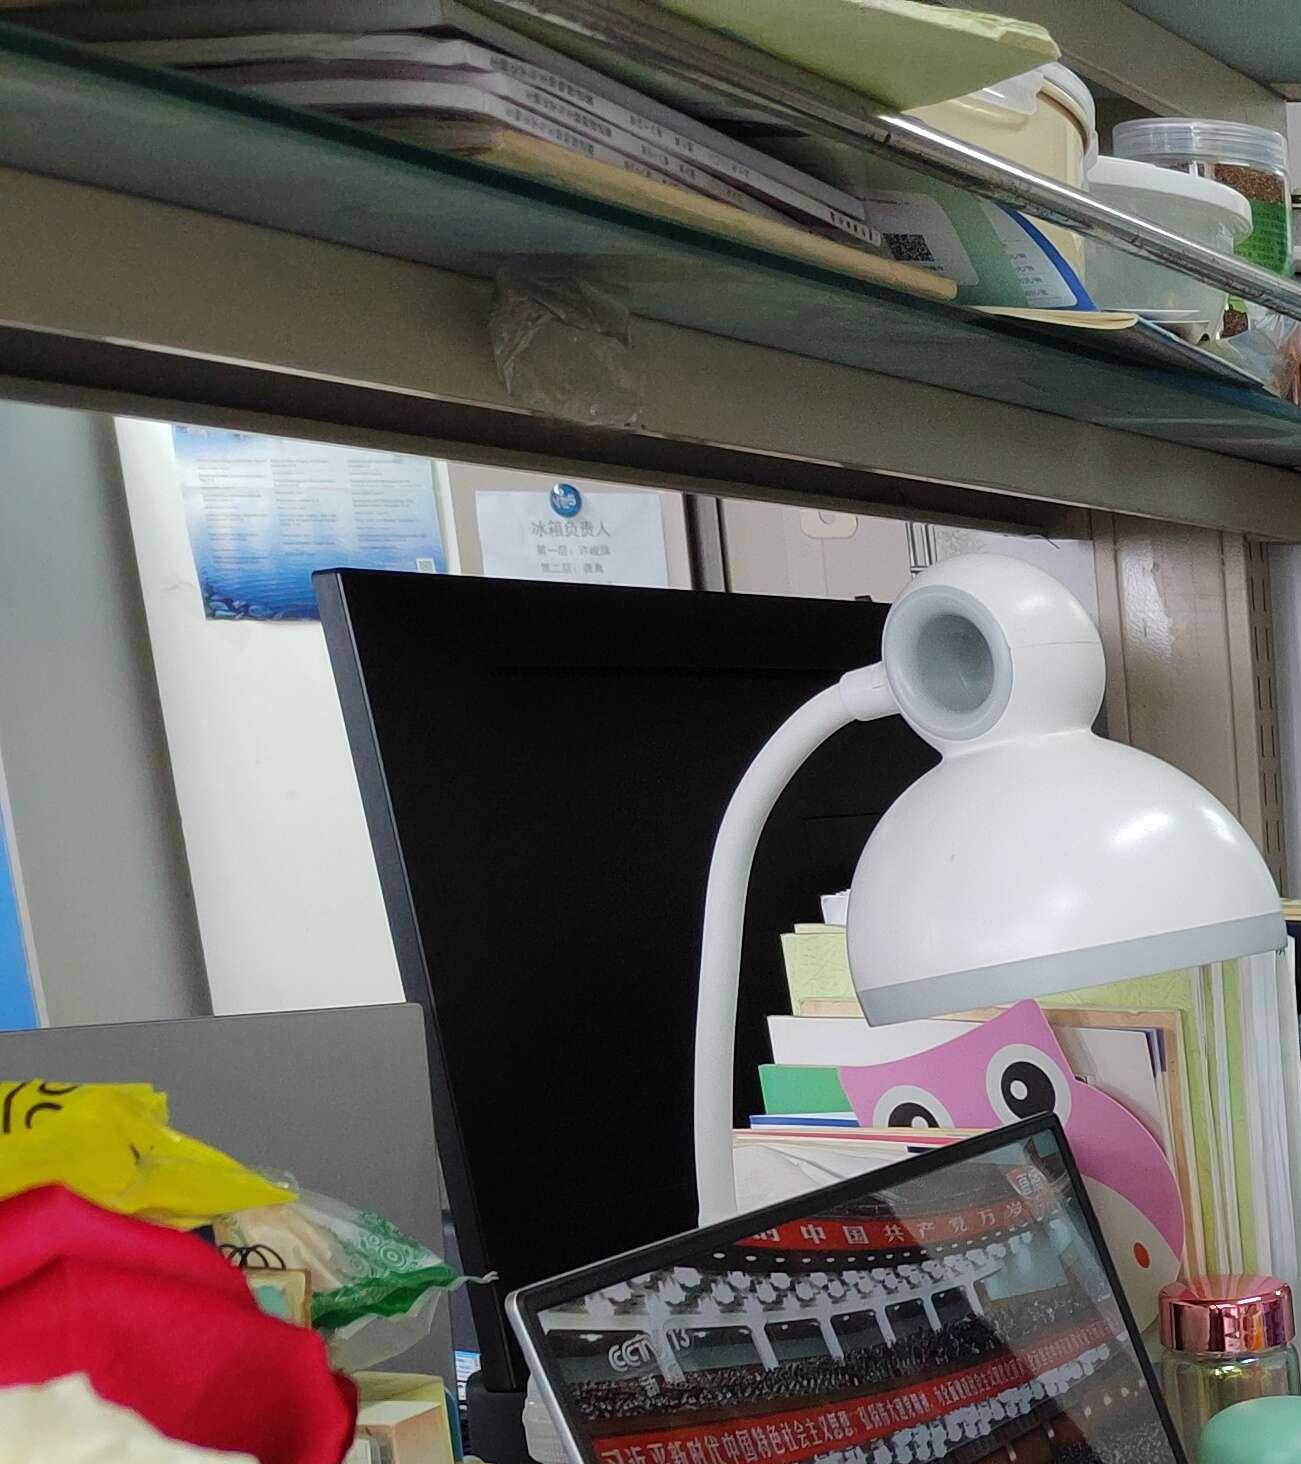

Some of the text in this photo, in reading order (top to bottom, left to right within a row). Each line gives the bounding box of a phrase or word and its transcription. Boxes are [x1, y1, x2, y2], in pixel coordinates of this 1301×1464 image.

[531, 520, 612, 538] 冰箱负责人
